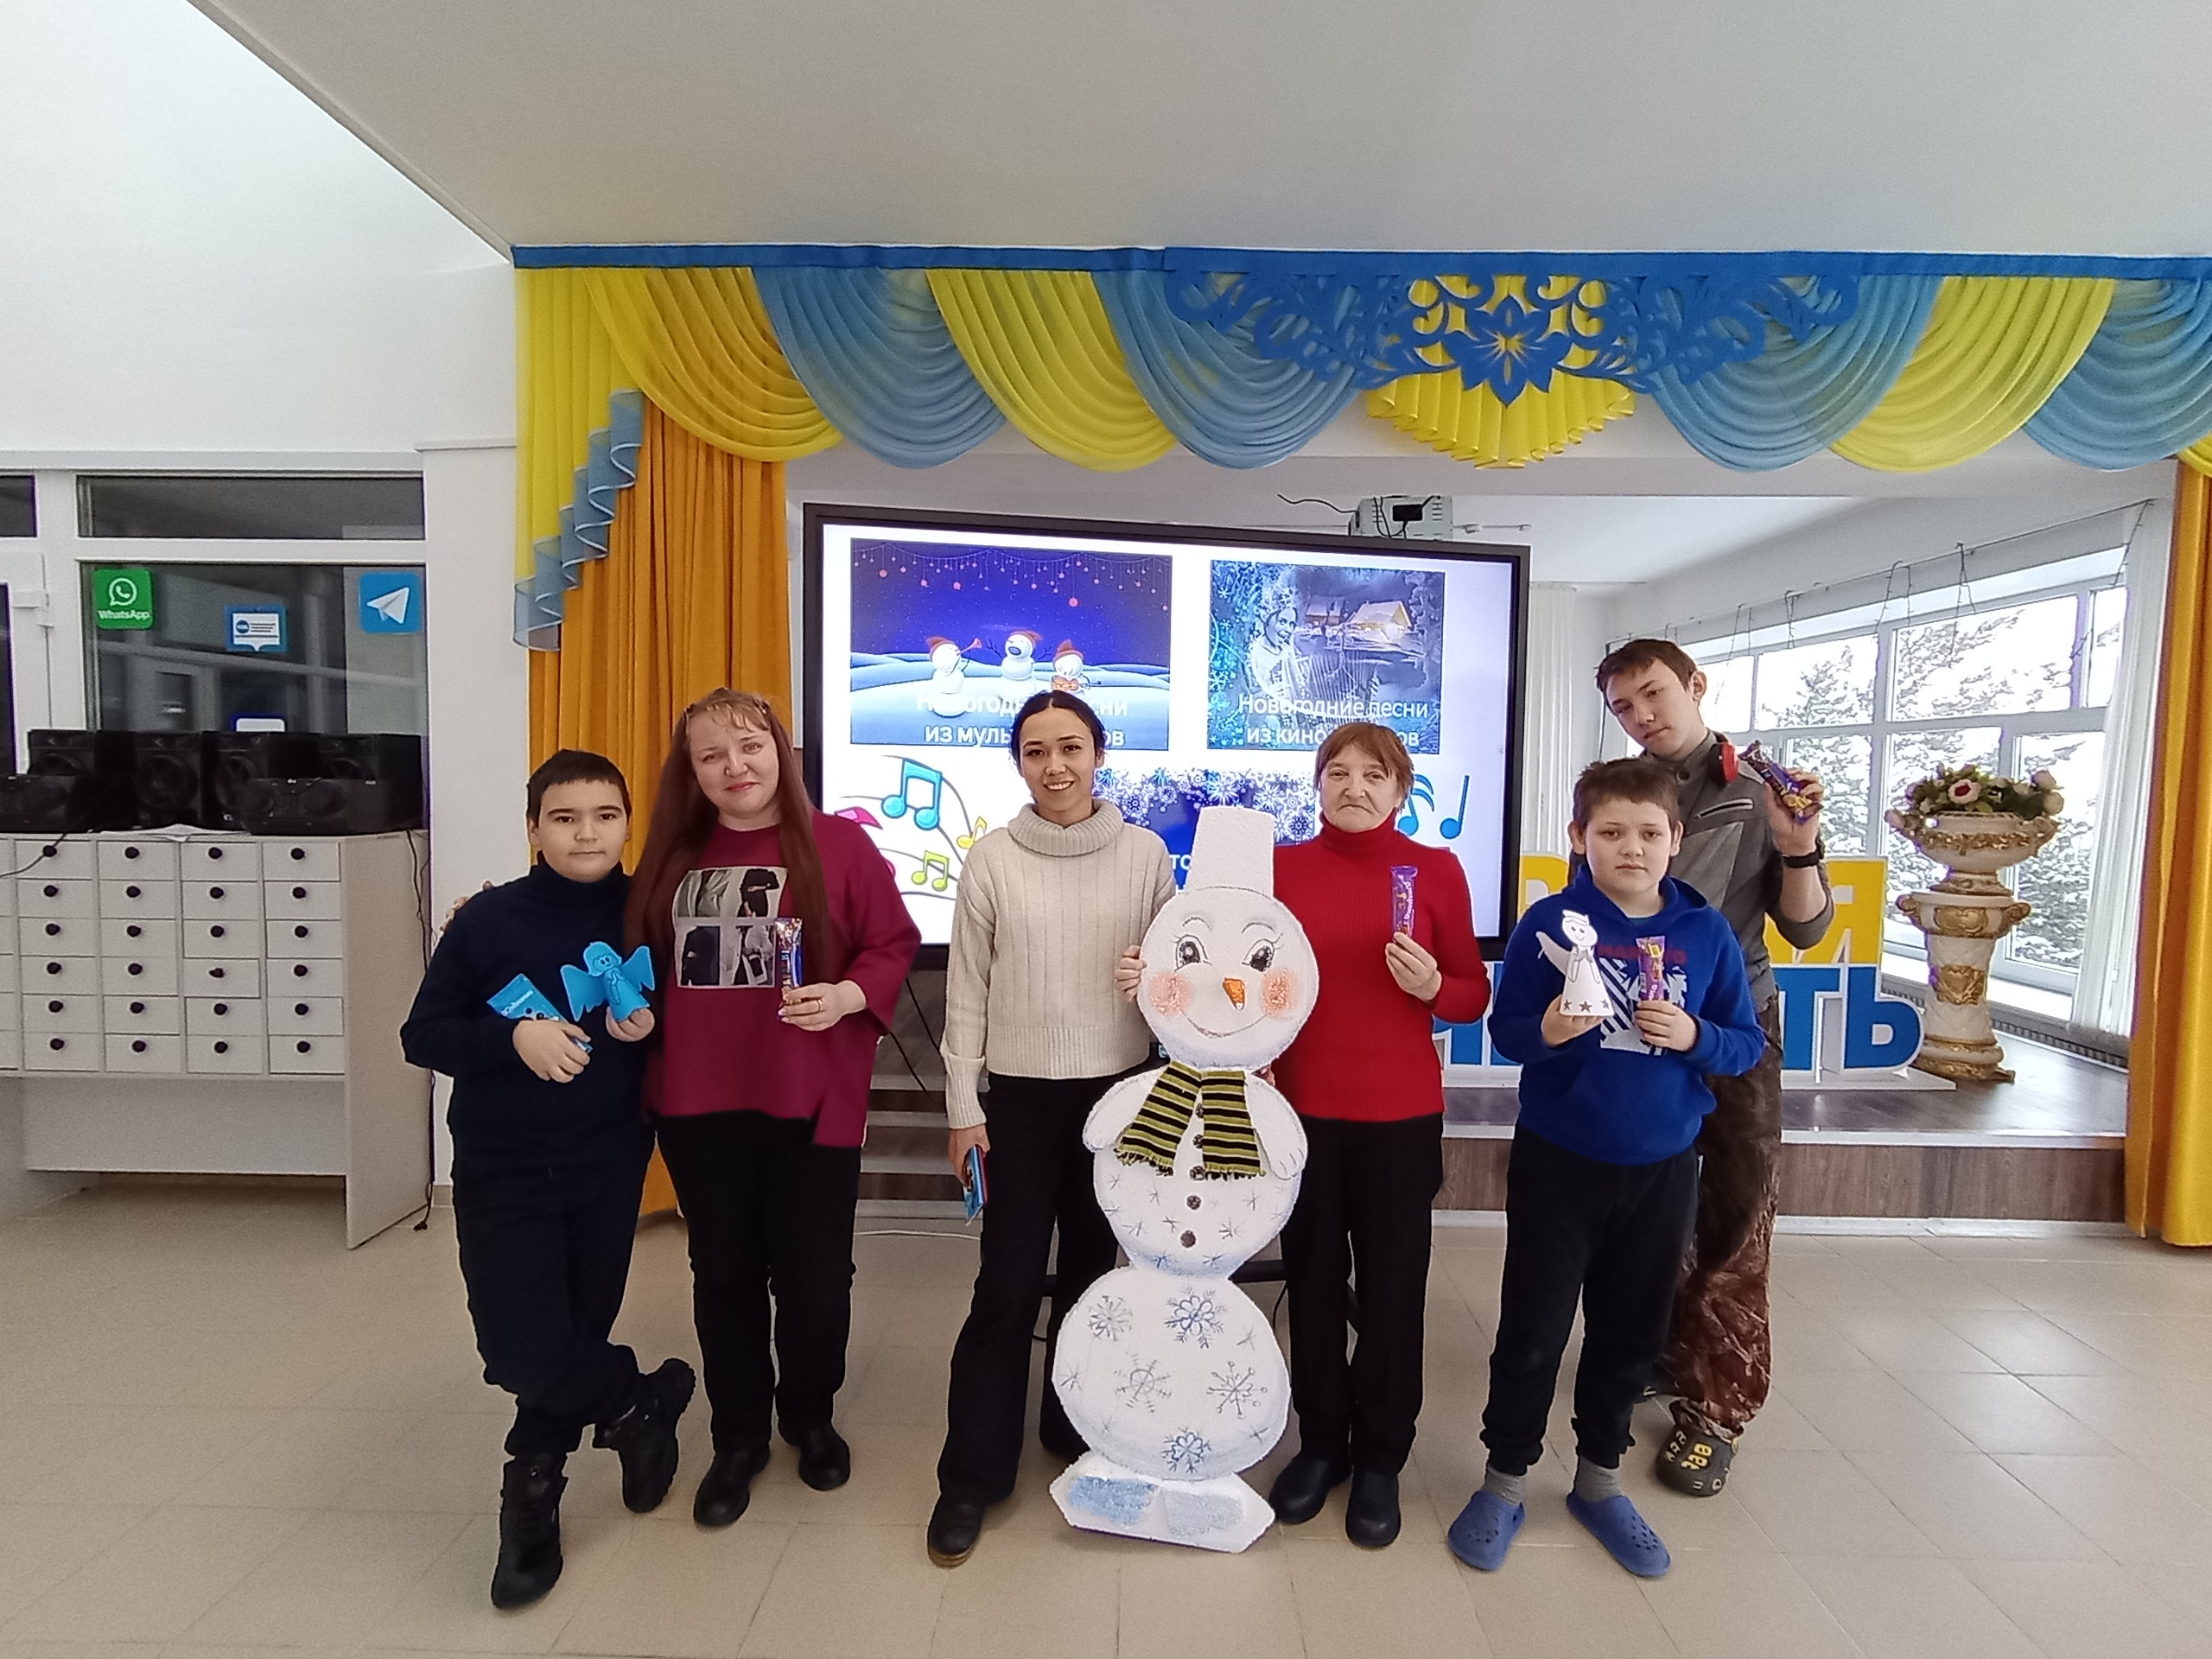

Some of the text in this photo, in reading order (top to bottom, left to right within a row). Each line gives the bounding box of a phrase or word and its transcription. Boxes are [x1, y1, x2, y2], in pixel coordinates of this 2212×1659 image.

[97, 609, 151, 620] WhatsApp
[1239, 694, 1428, 718] Новогодние песни
[925, 725, 953, 744] из
[1247, 728, 1274, 744] из
